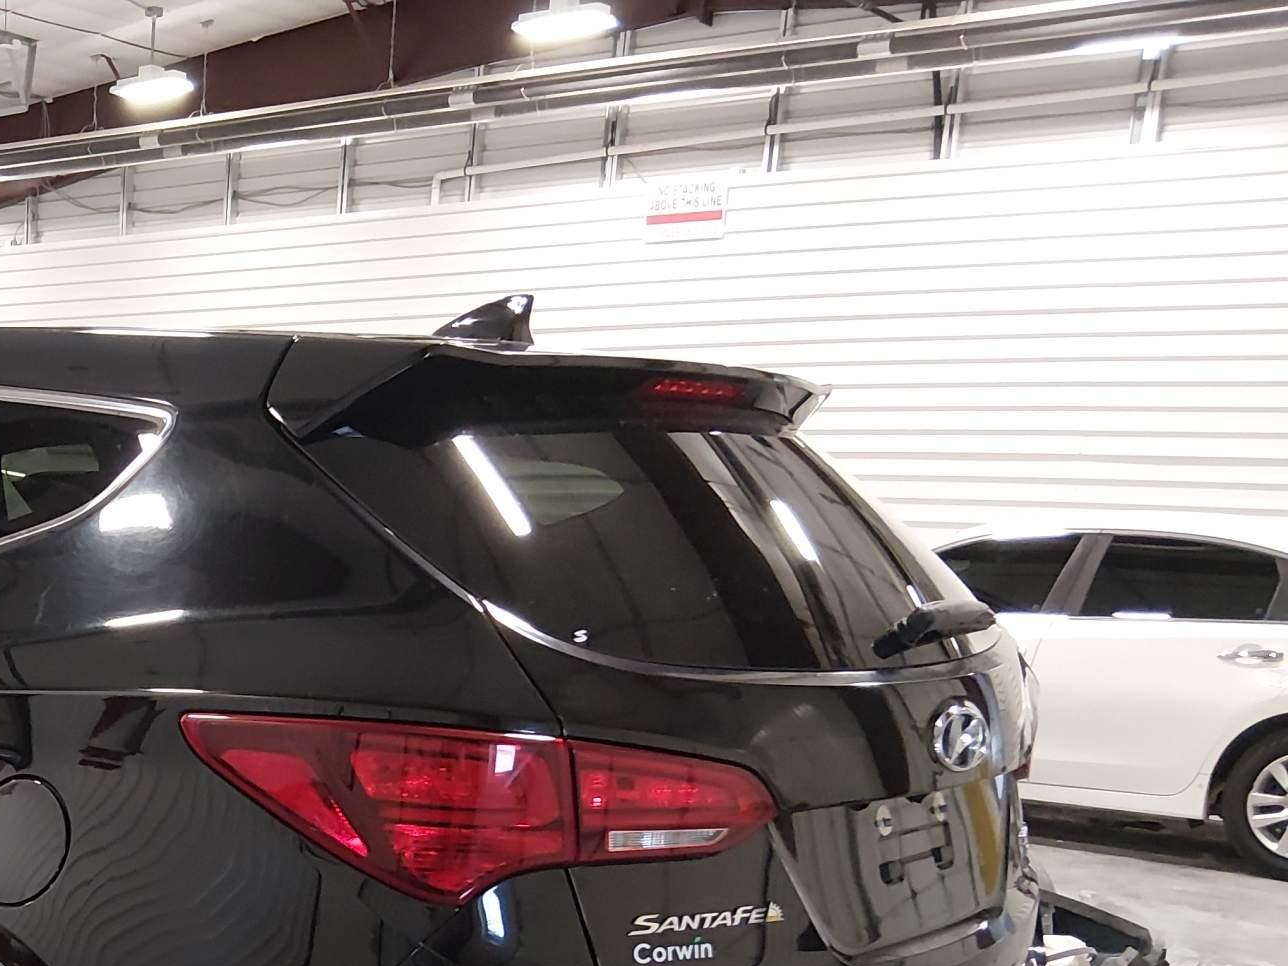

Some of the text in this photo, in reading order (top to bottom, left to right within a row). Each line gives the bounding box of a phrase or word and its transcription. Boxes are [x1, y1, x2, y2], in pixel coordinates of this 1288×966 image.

[681, 196, 700, 209] THIS
[702, 194, 722, 207] LINE
[633, 937, 713, 964] Corwin
